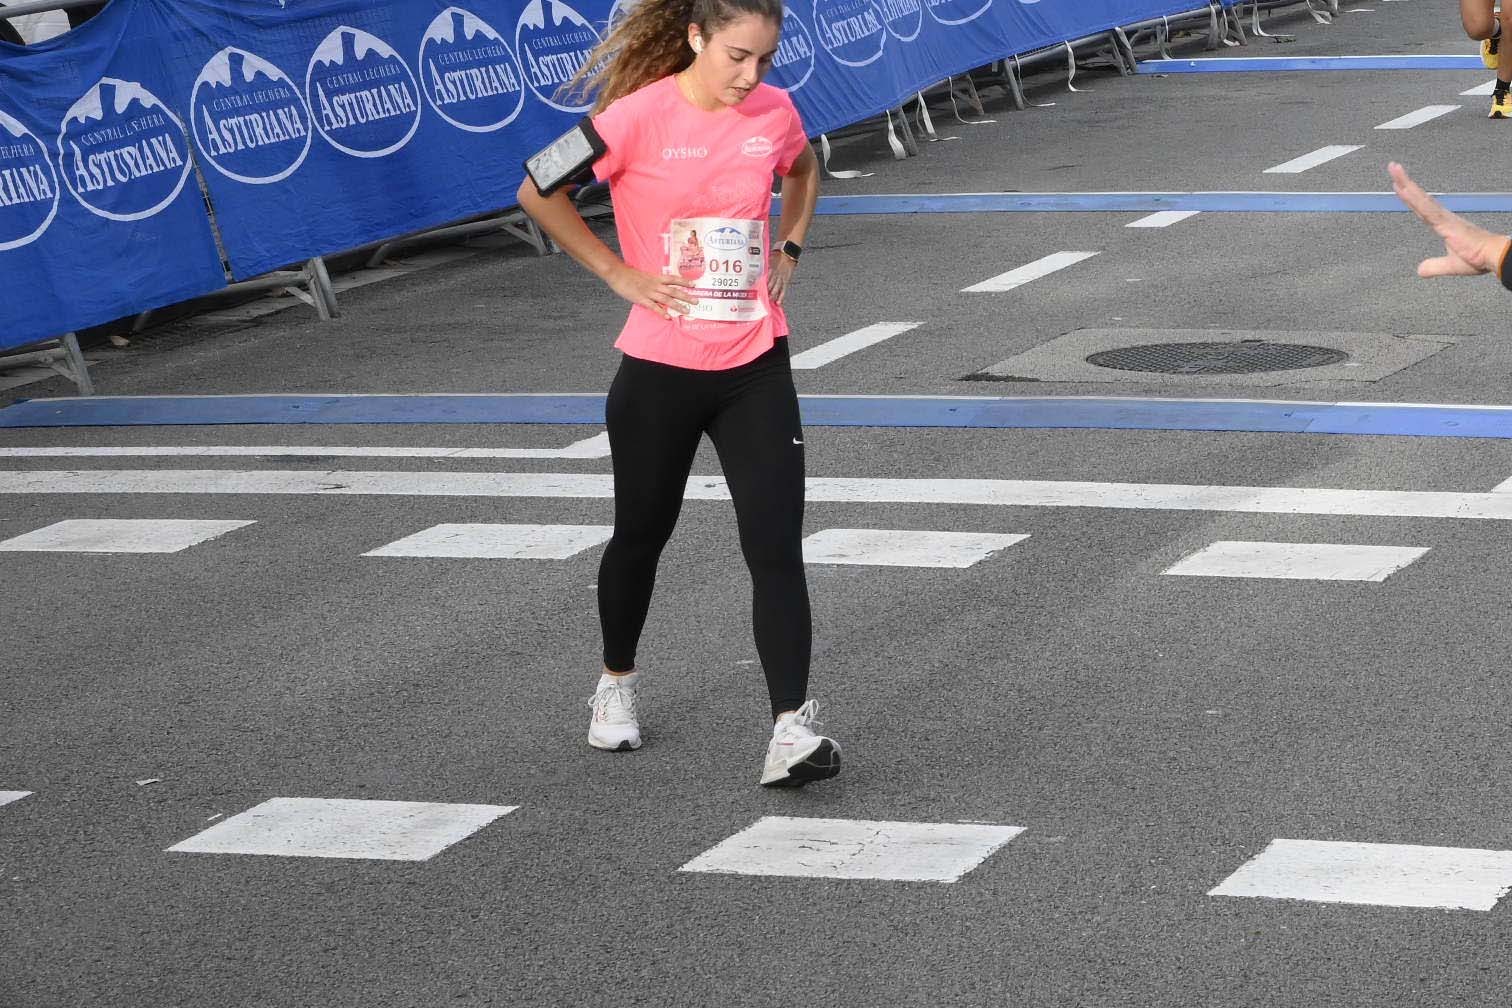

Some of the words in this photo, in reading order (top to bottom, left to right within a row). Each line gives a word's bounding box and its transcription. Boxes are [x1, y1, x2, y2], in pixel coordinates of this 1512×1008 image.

[531, 35, 562, 49] CENTRAL
[563, 31, 592, 45] LECHERA
[437, 49, 473, 65] CENTRAL
[473, 44, 505, 59] LECHERA
[524, 41, 596, 87] ASTURIA
[326, 72, 363, 89] CENTRAL
[363, 64, 401, 84] LECHERA
[428, 56, 522, 106] ASTURIANA
[213, 93, 252, 112] CENTRAL
[252, 87, 291, 106] LECHERA
[315, 80, 416, 132] ASTURIANA
[82, 124, 125, 147] CENTRAL
[202, 104, 306, 158] ASTURIANA
[0, 143, 34, 160] ECHERA
[662, 147, 708, 160] OYSHO
[709, 258, 743, 274] 016
[711, 277, 739, 287] 29025
